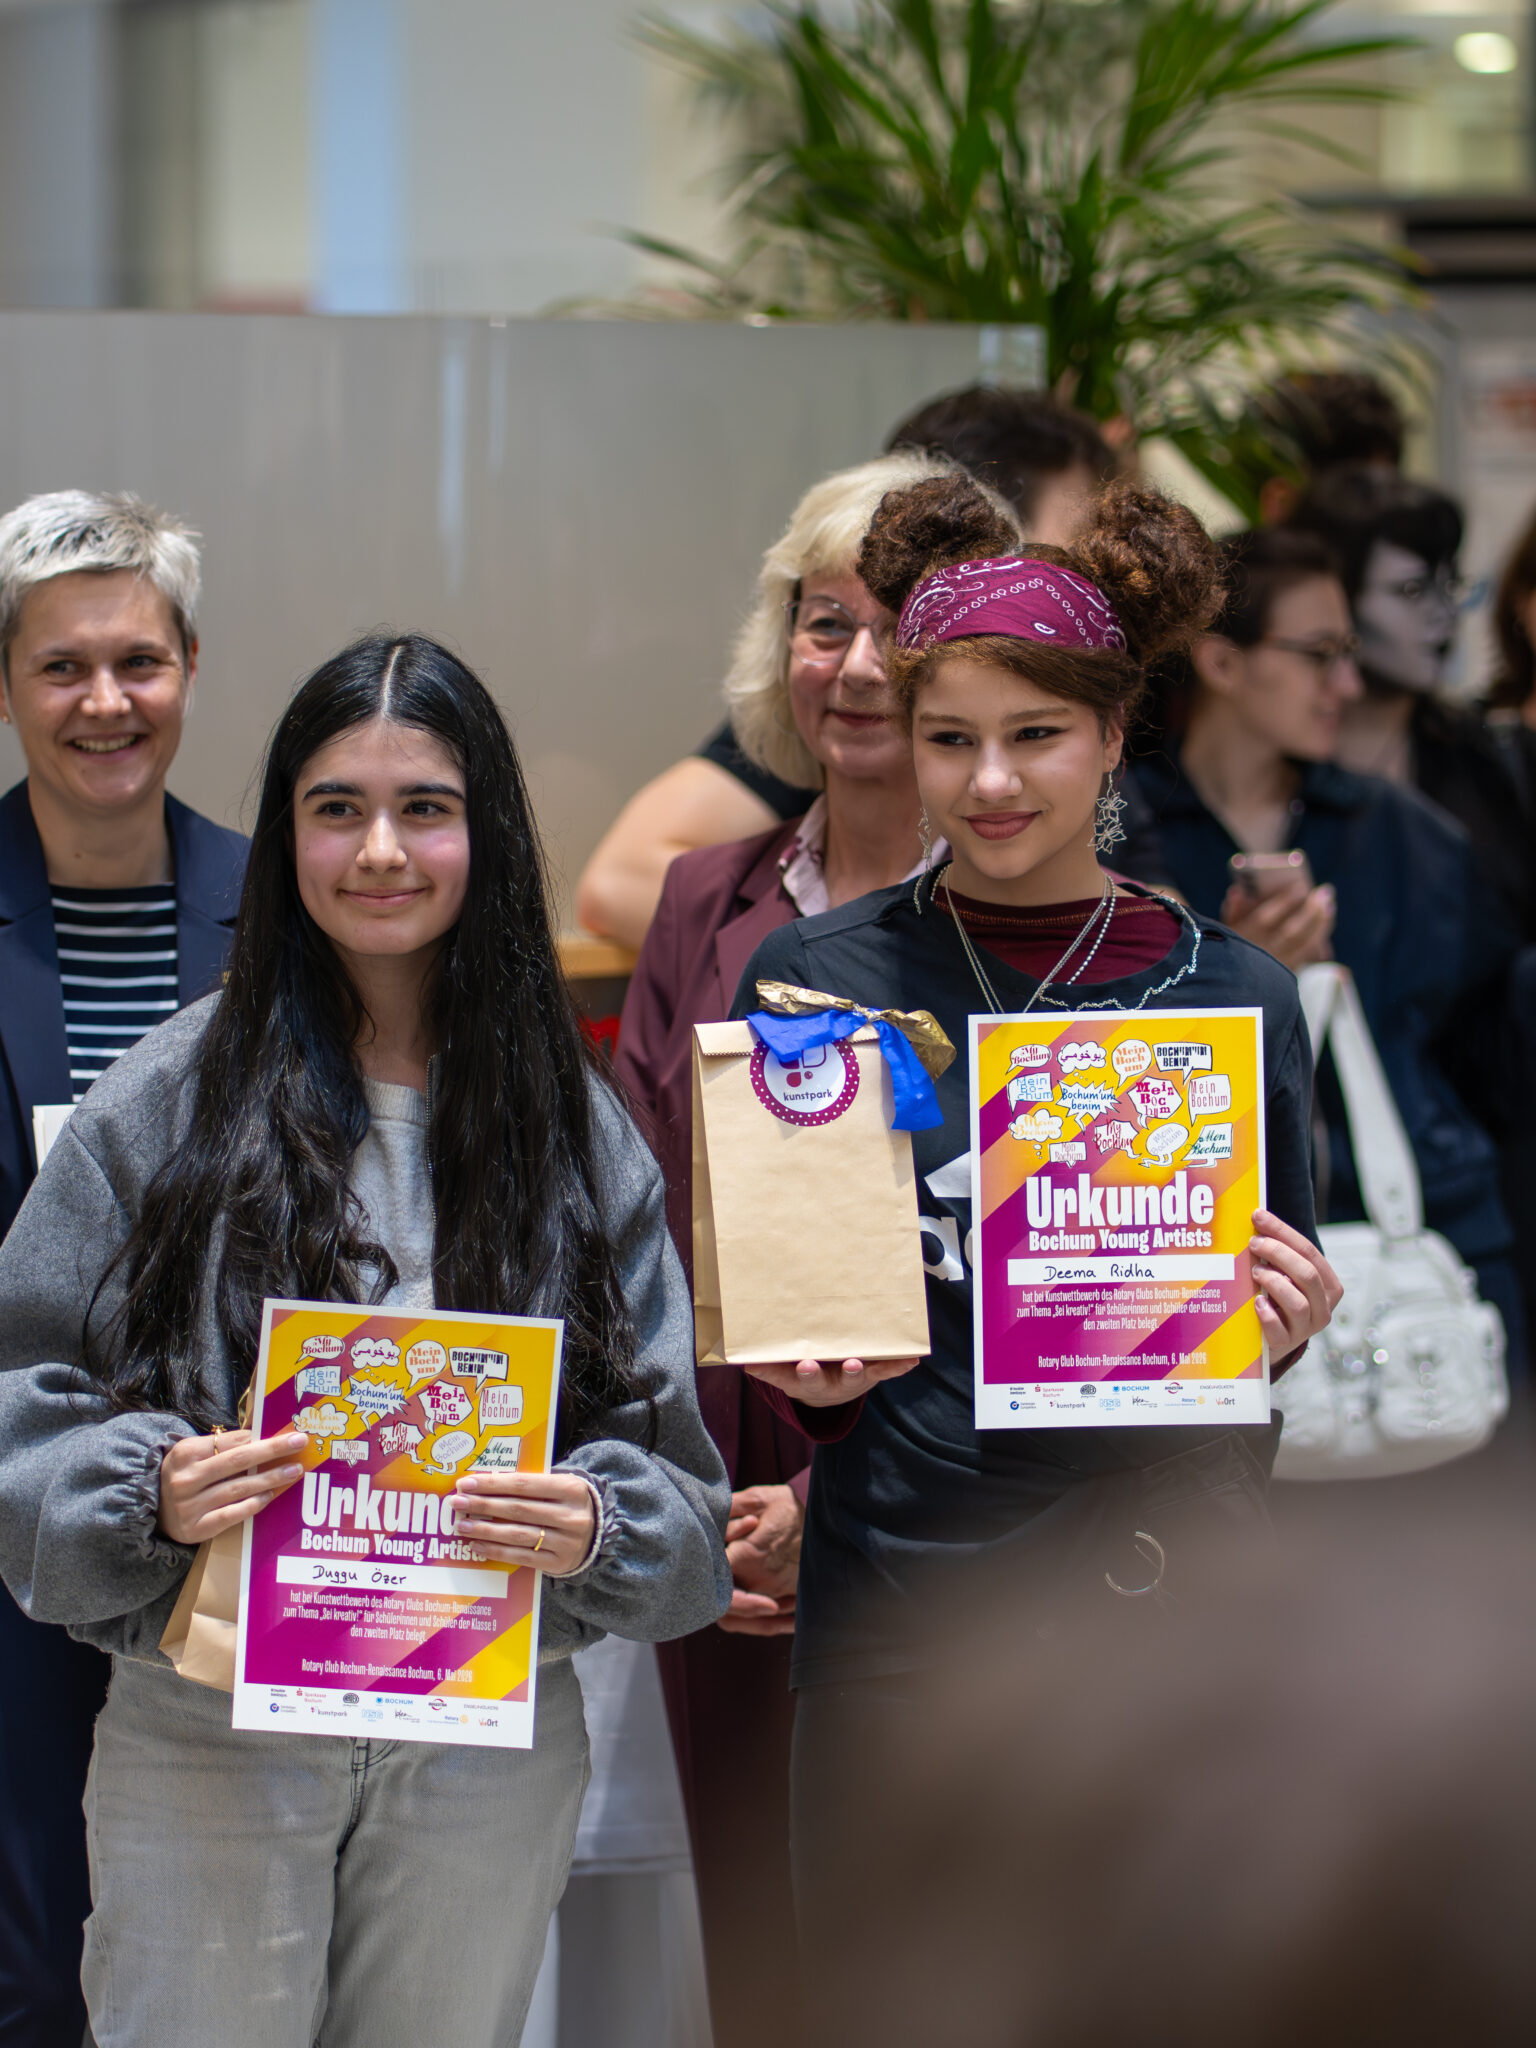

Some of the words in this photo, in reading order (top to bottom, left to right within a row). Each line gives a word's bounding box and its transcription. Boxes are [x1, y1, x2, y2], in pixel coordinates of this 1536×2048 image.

[1116, 1045, 1145, 1056] Mein
[1011, 1053, 1050, 1064] Bochum
[1116, 1055, 1145, 1065] Boch
[1124, 1064, 1142, 1072] um
[1016, 1077, 1048, 1086] Mein
[1021, 1083, 1044, 1093] Bo-
[1136, 1081, 1175, 1096] Mein
[1191, 1080, 1216, 1094] Mein
[783, 1088, 832, 1101] kunstpark
[1017, 1089, 1053, 1101] chum
[1140, 1094, 1166, 1106] Boc
[1191, 1095, 1228, 1108] Bochum
[1071, 1099, 1101, 1110] benim
[1145, 1105, 1171, 1118] hum
[1106, 1119, 1122, 1140] My
[1094, 1132, 1133, 1150] Bochum
[1188, 1143, 1231, 1155] Bochum
[1026, 1170, 1214, 1229] Urkunde
[1029, 1230, 1096, 1251] Bochum
[1098, 1229, 1149, 1254] Young
[1152, 1227, 1212, 1248] Artists
[1043, 1265, 1096, 1281] Deema
[1110, 1263, 1155, 1279] Ridha
[1022, 1290, 1033, 1303] hat
[1034, 1290, 1044, 1303] bei
[1045, 1289, 1100, 1302] Kunstwettbewerb
[1101, 1288, 1113, 1301] des
[1113, 1288, 1135, 1303] Rotary
[1135, 1287, 1153, 1300] Clubs
[1154, 1286, 1221, 1300] Bochum-Renaissance
[1016, 1308, 1030, 1318] zum
[1030, 1305, 1052, 1318] Thema
[1095, 1303, 1105, 1316] für
[1106, 1302, 1149, 1315] Schülerinnen
[1150, 1301, 1162, 1314] und
[1163, 1300, 1188, 1314] Schüler
[1188, 1301, 1200, 1313] der
[1201, 1300, 1222, 1313] Klasse
[1083, 1318, 1096, 1331] den
[1096, 1318, 1121, 1330] zweiten
[1121, 1317, 1137, 1330] Platz
[304, 1344, 342, 1355] Bochum
[410, 1347, 441, 1357] Mein
[409, 1356, 439, 1366] Boch
[1038, 1355, 1060, 1371] Rotary
[1060, 1354, 1075, 1368] Club
[1142, 1353, 1170, 1366] Bochum,
[1171, 1352, 1178, 1365] 6.
[1179, 1352, 1190, 1365] Mai
[305, 1367, 337, 1378] Mein
[417, 1366, 436, 1374] um
[308, 1375, 332, 1385] Bo-
[305, 1382, 341, 1393] chum
[427, 1385, 466, 1402] Mein
[358, 1397, 389, 1410] benim
[483, 1389, 508, 1404] Mein
[430, 1397, 456, 1412] Boc
[482, 1402, 520, 1419] Bochum
[1056, 1402, 1086, 1410] kunstpark
[433, 1410, 460, 1425] hum
[392, 1420, 408, 1442] My
[379, 1434, 418, 1453] Bochum
[474, 1454, 518, 1468] Bochum
[301, 1528, 370, 1554] Bochum
[373, 1533, 425, 1563] Young
[371, 1567, 407, 1585] Özer
[290, 1589, 301, 1603] hat
[302, 1590, 313, 1603] bei
[313, 1591, 370, 1607] Kunstwettbewerb
[371, 1595, 383, 1608] des
[383, 1596, 405, 1613] Rotary
[405, 1598, 424, 1611] Clubs
[425, 1599, 492, 1616] Bochum-Renaissance
[283, 1607, 297, 1618] zum
[297, 1606, 319, 1620] Thema
[363, 1610, 375, 1623] für
[375, 1611, 418, 1626] Schülerinnen
[419, 1615, 431, 1627] und
[432, 1615, 458, 1629] Schüler
[458, 1617, 471, 1630] der
[471, 1617, 492, 1631] Klasse
[492, 1619, 497, 1632] 9
[350, 1624, 363, 1637] den
[363, 1627, 389, 1639] zweiten
[389, 1627, 405, 1641] Platz
[301, 1658, 324, 1676] Rotary
[324, 1660, 340, 1674] Club
[340, 1661, 407, 1679] Bochum-Renaissance
[407, 1666, 436, 1681] Bochum,
[437, 1668, 444, 1681] 6.
[445, 1668, 456, 1682] Mai
